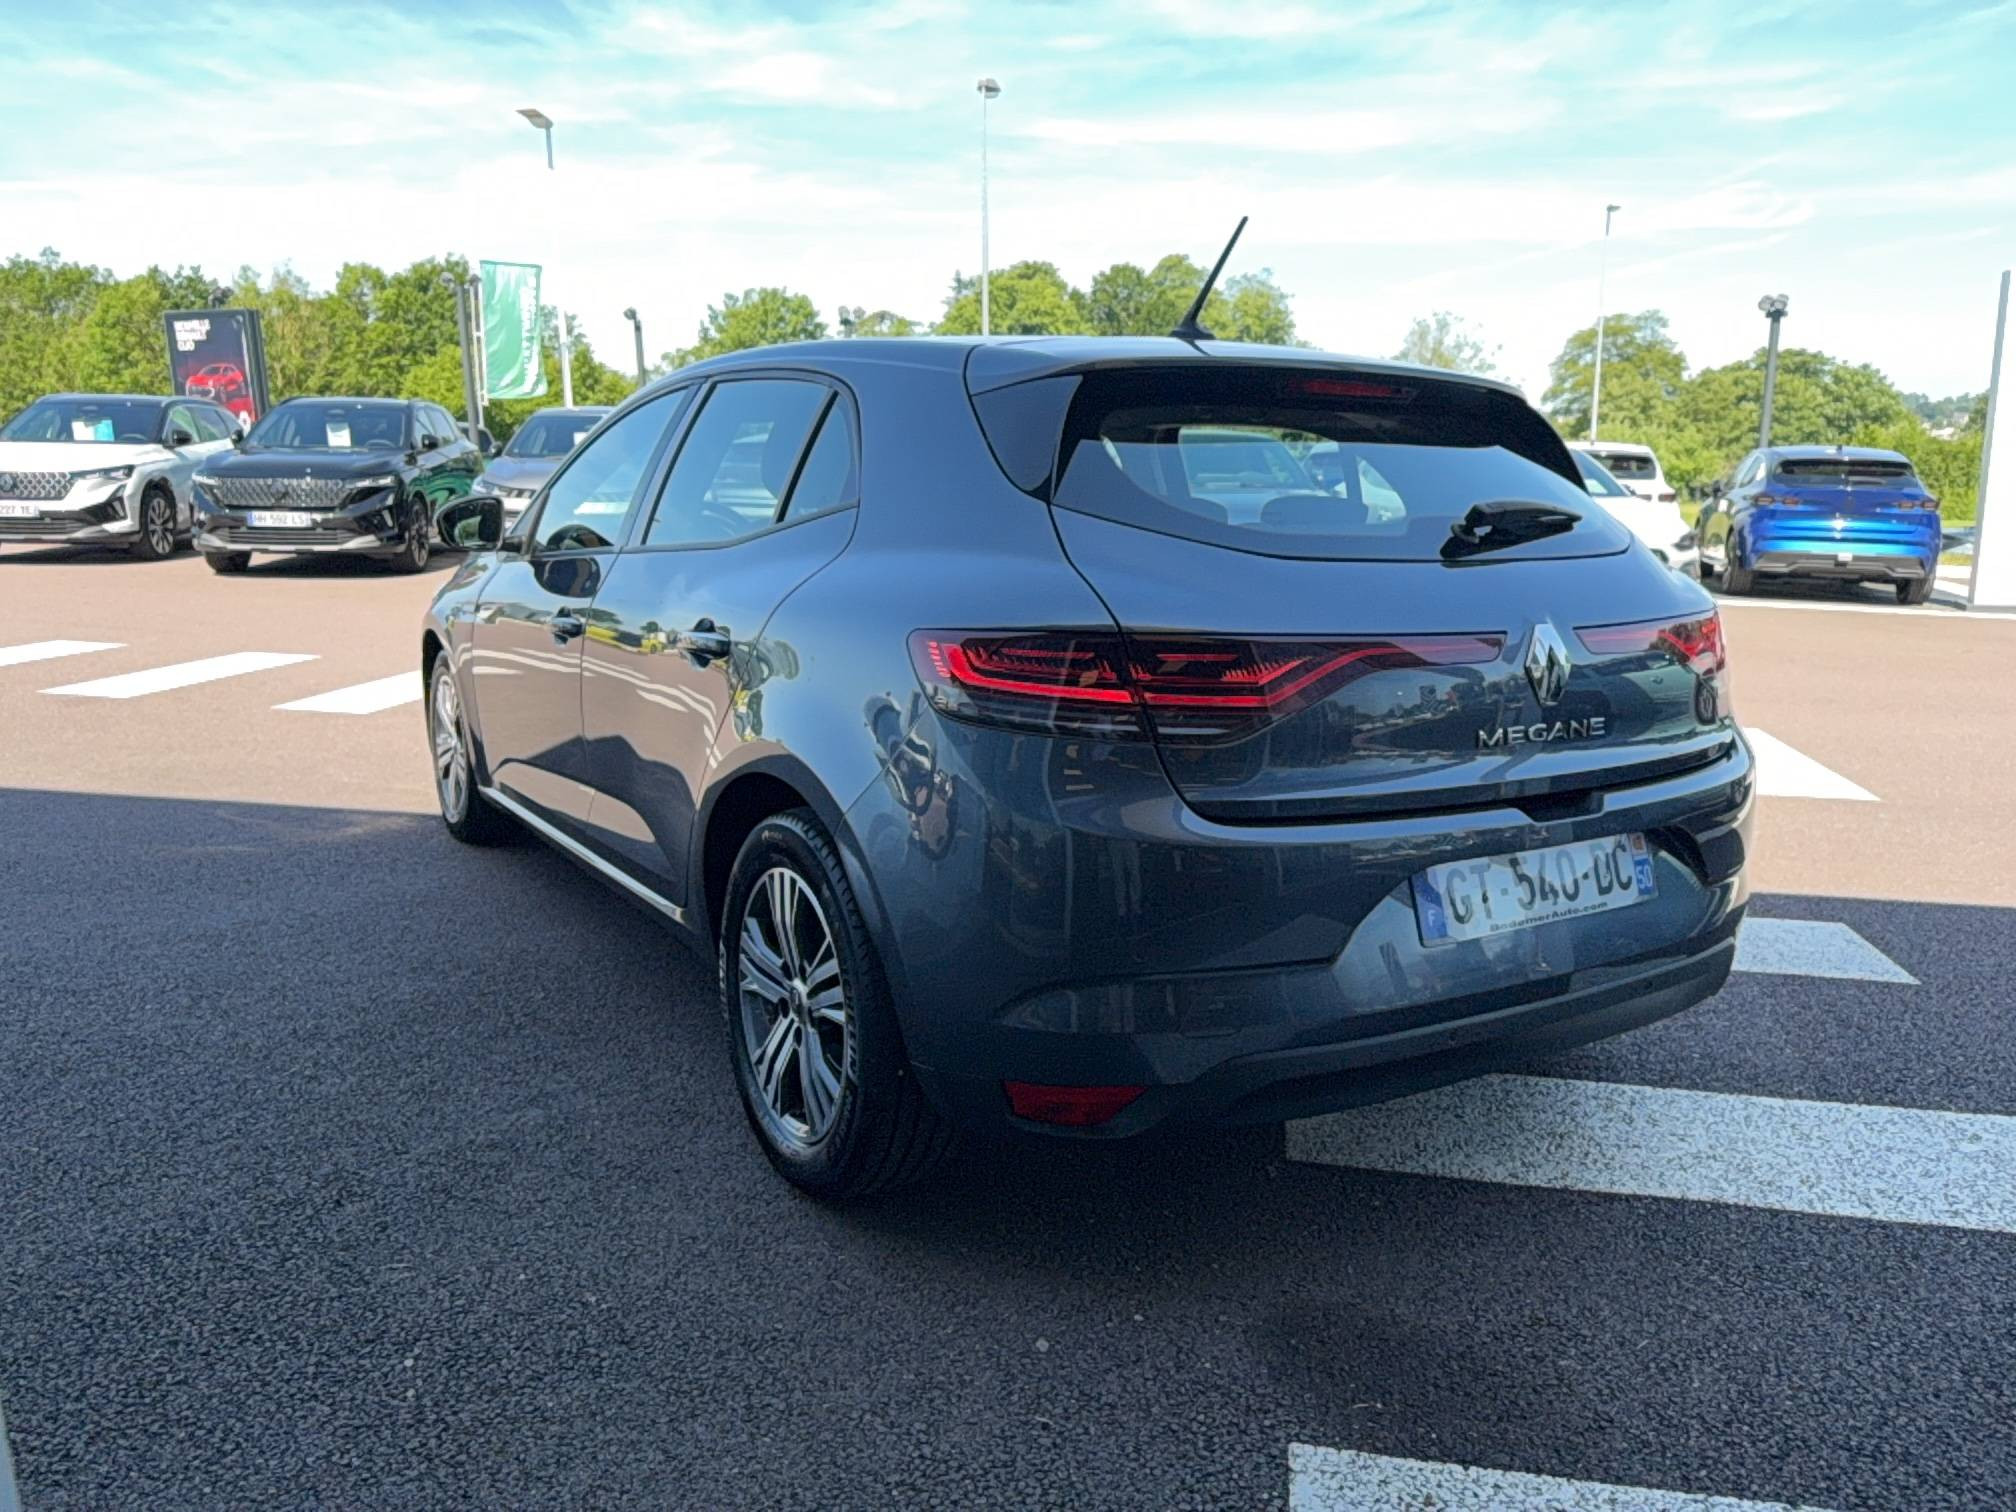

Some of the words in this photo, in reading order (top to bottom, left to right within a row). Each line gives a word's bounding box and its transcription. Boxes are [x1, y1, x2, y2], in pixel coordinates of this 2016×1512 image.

[1477, 716, 1606, 749] MEGANE
[1635, 864, 1653, 889] 50
[1427, 910, 1436, 927] F
